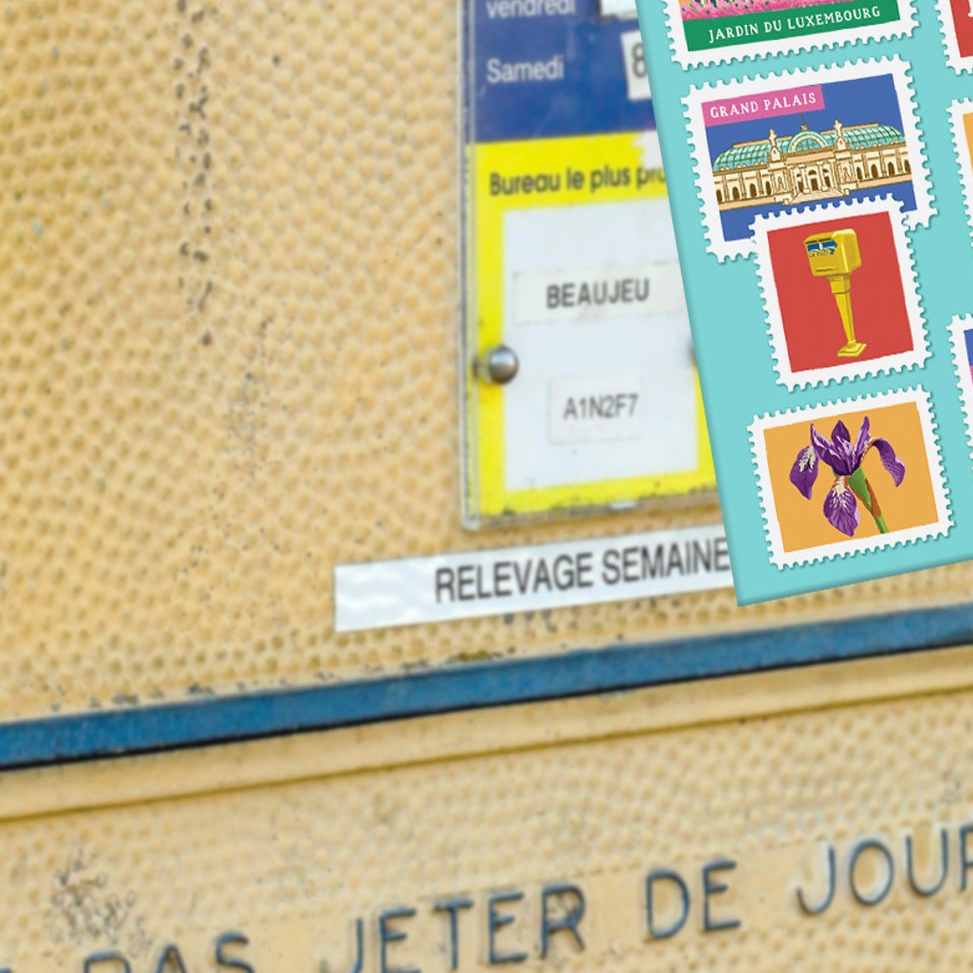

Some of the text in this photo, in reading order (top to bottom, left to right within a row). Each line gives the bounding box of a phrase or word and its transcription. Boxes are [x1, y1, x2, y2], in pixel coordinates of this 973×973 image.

[708, 6, 881, 43] JARDIN DU LUXEMBOURG
[486, 55, 564, 84] Samedi
[710, 92, 817, 119] GRAND PALAIS
[489, 169, 560, 197] Bureau
[566, 167, 585, 191] le
[590, 164, 631, 194] plus
[546, 277, 651, 310] BEAUJEU
[563, 393, 640, 420] A1N2F7
[434, 537, 730, 604] RELEVAGE SEMAINE
[319, 883, 586, 973] JETER
[643, 859, 743, 942] DE
